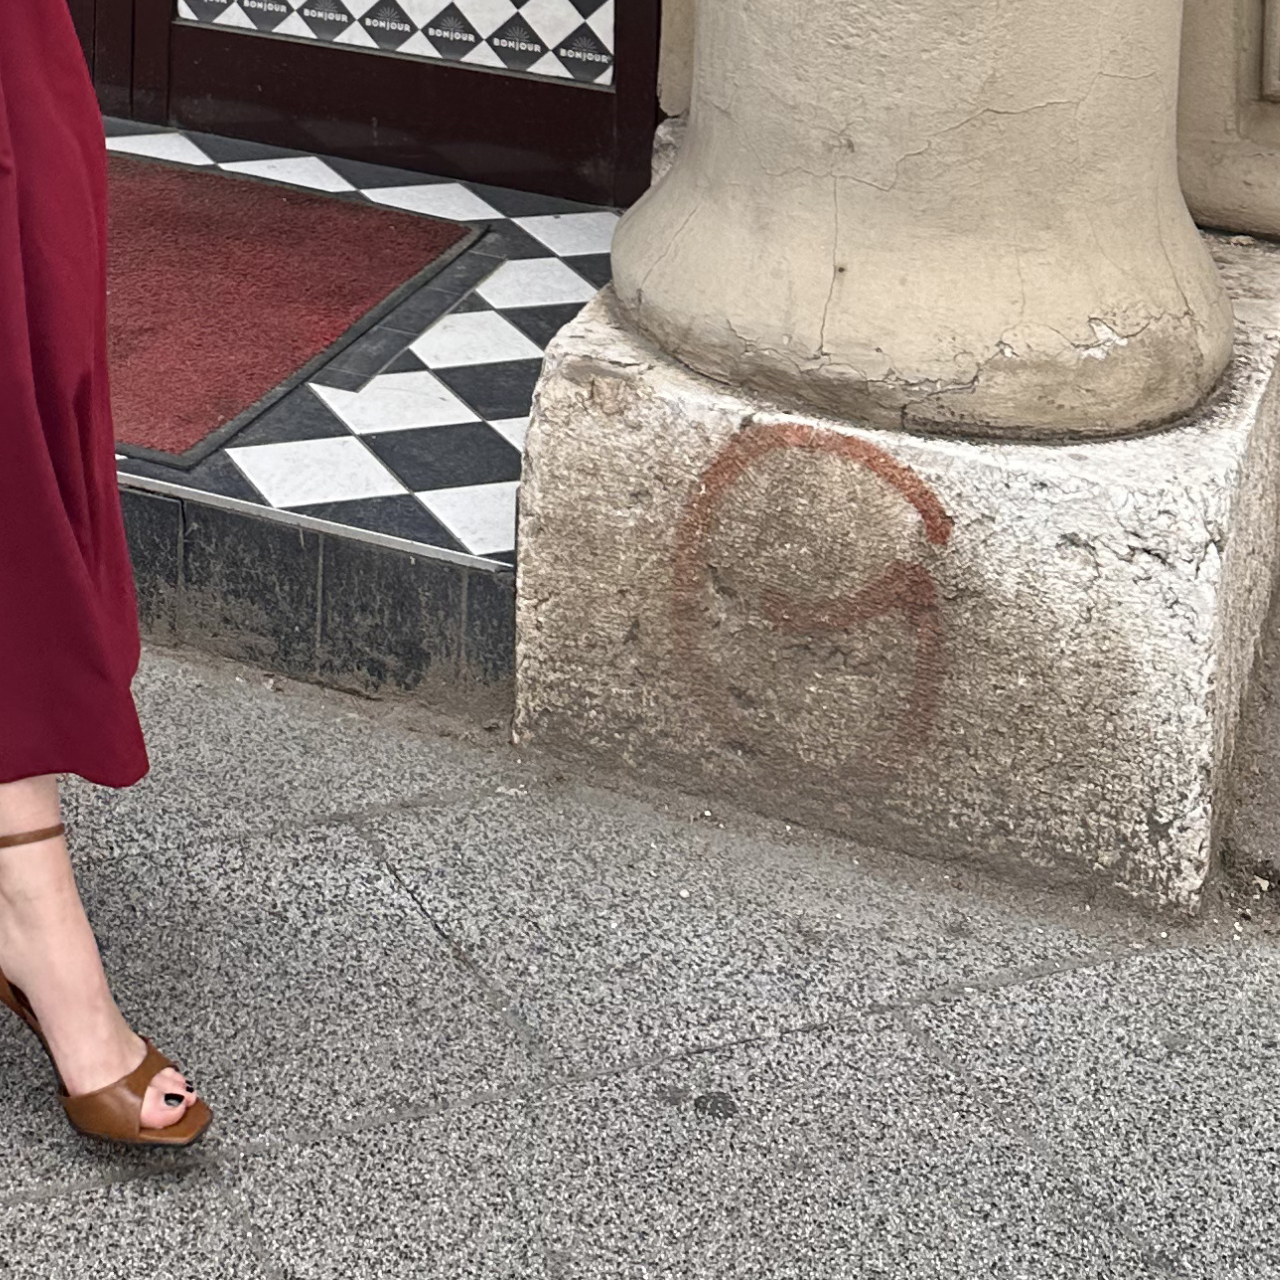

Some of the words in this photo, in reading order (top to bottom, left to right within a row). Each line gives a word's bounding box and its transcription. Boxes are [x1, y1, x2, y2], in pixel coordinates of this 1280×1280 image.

[243, 0, 287, 13] BONJOUR
[303, 8, 348, 23] BONJOUR
[365, 18, 411, 32] BONJOUR
[428, 27, 475, 42] BONJOUR
[493, 38, 541, 53] BONJOUR
[560, 48, 609, 63] BONJOUR
